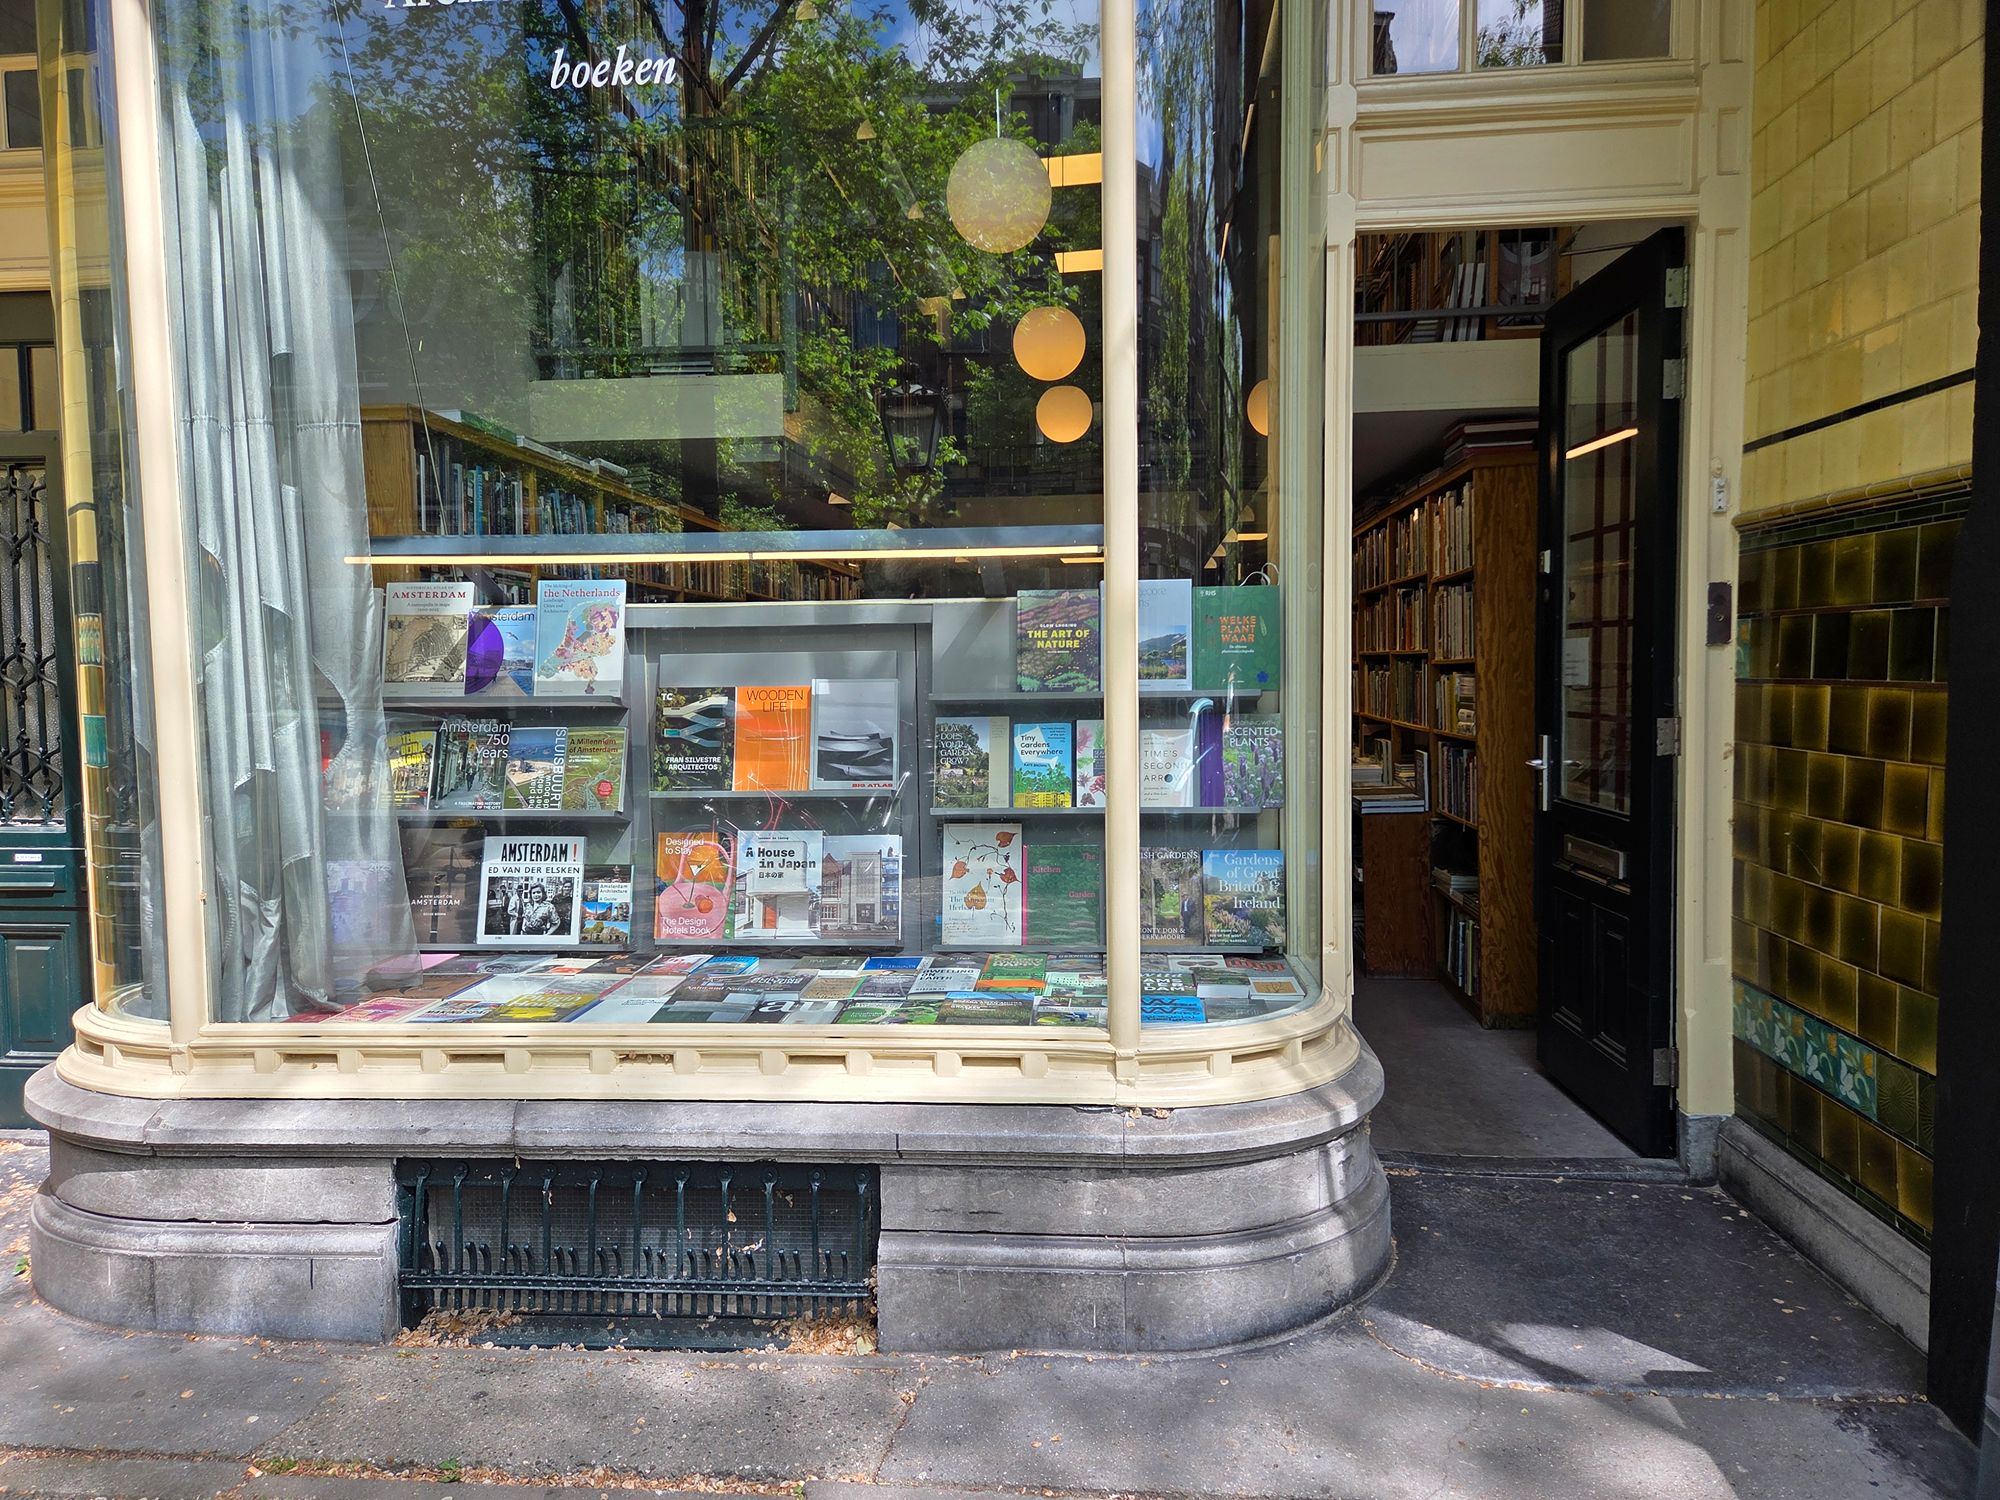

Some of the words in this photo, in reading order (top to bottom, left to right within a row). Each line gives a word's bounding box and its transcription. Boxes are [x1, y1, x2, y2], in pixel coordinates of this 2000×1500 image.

[551, 45, 676, 89] boeken
[392, 591, 467, 599] AMSTERDAM
[544, 589, 559, 598] the
[562, 588, 621, 598] Netherlands
[1219, 616, 1256, 624] WELKE
[1220, 625, 1256, 633] PLANT
[1027, 630, 1048, 638] THE
[1051, 630, 1073, 638] ART
[1075, 630, 1090, 638] OF
[1222, 634, 1255, 643] WAAR
[1037, 640, 1080, 648] NATURE
[661, 693, 673, 701] TC
[747, 689, 804, 701] WOODEN
[762, 701, 787, 713] LIFE
[439, 721, 511, 733] Amsterdam
[1230, 727, 1278, 736] SCENTED
[486, 734, 510, 746] 750
[1230, 737, 1270, 747] PLANTS
[941, 741, 964, 749] YOUR
[475, 747, 509, 759] Years
[940, 749, 973, 757] GARDEN
[1021, 749, 1064, 757] Everywhere
[1144, 750, 1178, 758] TIME'S
[665, 756, 684, 764] FRAN
[940, 757, 969, 765] GROW?
[550, 729, 567, 808] SLUISBUURT
[668, 763, 718, 771] ARQUITECTOS
[543, 775, 551, 797] bouw
[543, 799, 550, 808] de
[665, 837, 704, 847] Designed
[501, 843, 568, 862] AMSTERDAM
[573, 844, 578, 862] !
[665, 847, 673, 855] to
[675, 847, 692, 855] Stay
[746, 848, 754, 857] A
[758, 848, 795, 857] House
[1157, 851, 1199, 859] GARDENS
[759, 859, 774, 868] in
[778, 858, 816, 870] Japan
[1224, 853, 1280, 866] Gardens
[1227, 867, 1240, 878] of
[1243, 867, 1279, 879] Great
[1220, 879, 1264, 892] Britain
[1269, 880, 1280, 892] &
[1234, 897, 1280, 909] Ireland
[661, 917, 676, 925] The
[678, 917, 707, 927] Design
[662, 926, 688, 934] Hotels
[690, 926, 711, 934] Book
